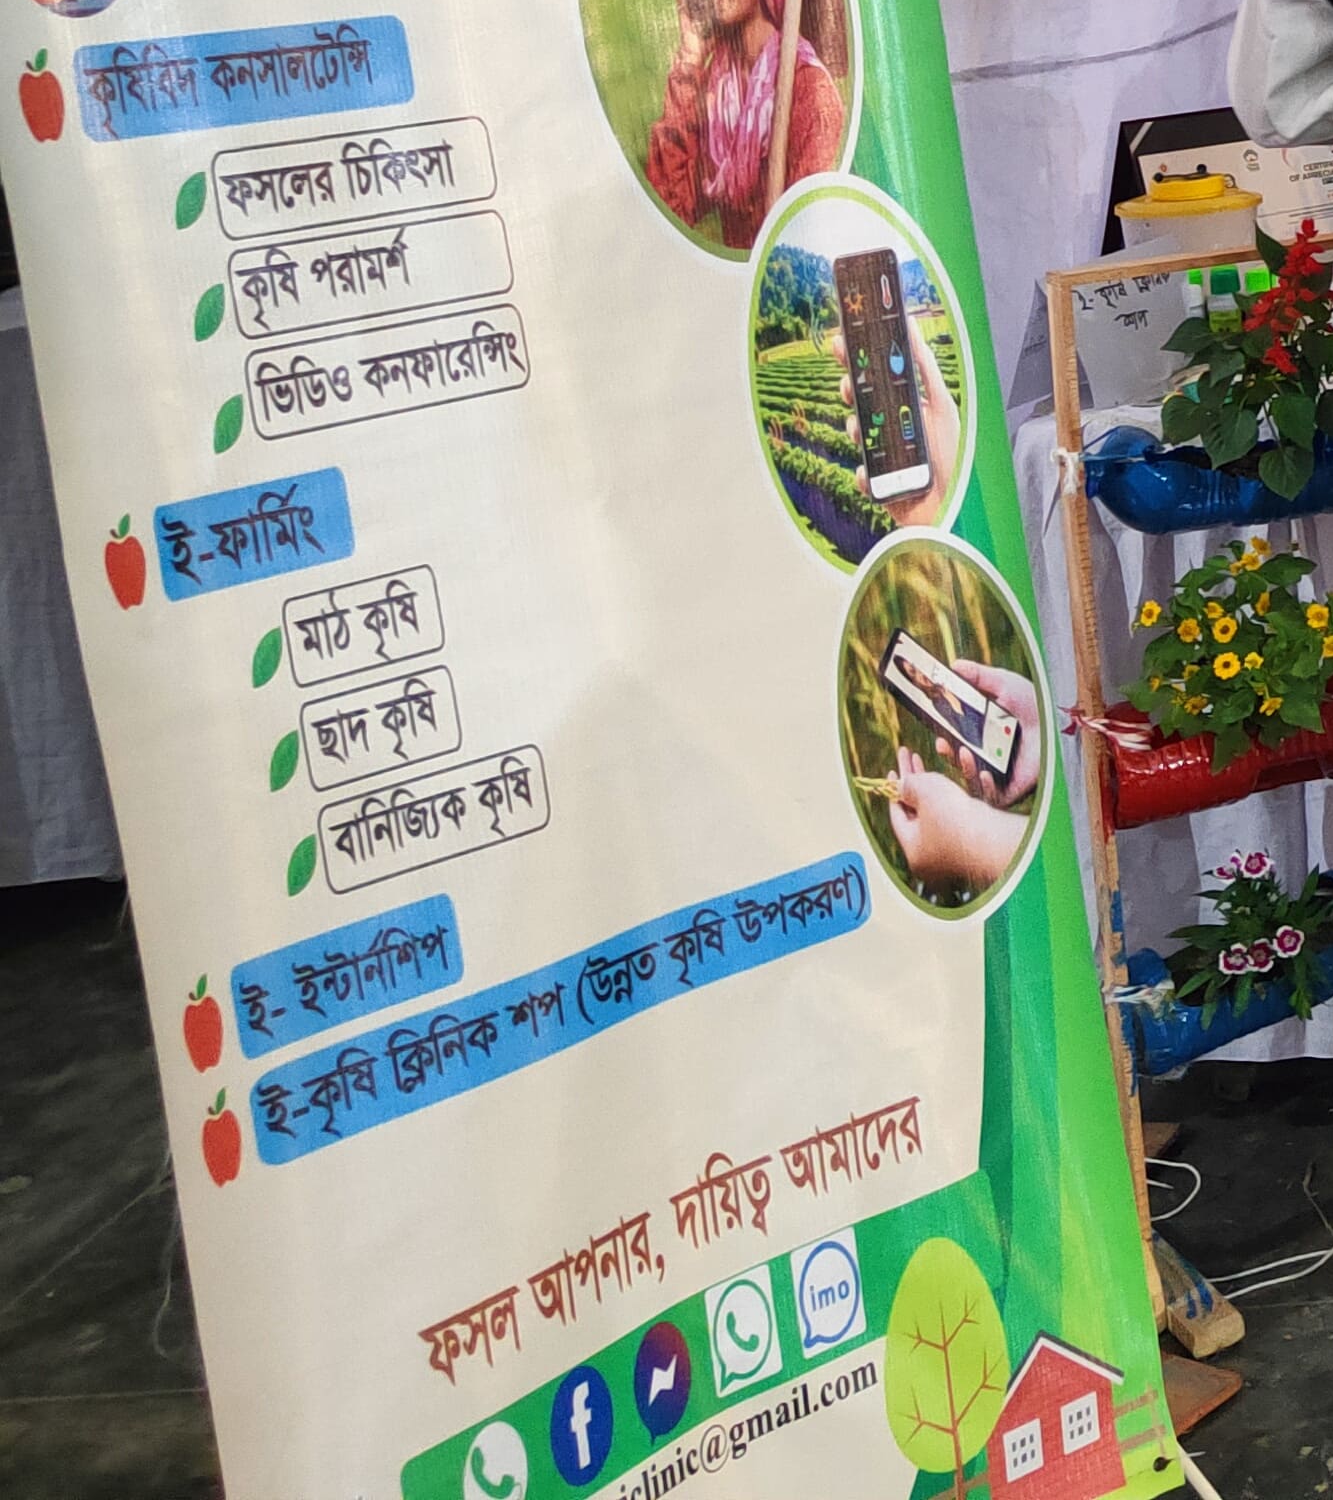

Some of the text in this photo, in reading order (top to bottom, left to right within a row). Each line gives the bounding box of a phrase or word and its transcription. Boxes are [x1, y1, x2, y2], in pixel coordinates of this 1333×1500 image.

[219, 137, 456, 217] ফসলের চিকিৎসা
[235, 225, 411, 331] কৃষি পরামর্শ
[254, 354, 353, 423] ভিডিও
[161, 483, 327, 586] ই-ফার্মিং
[293, 579, 419, 661] মাঠ কৃষি
[312, 676, 439, 762] ছাদ কৃষি
[472, 754, 537, 838] কৃষি
[256, 868, 868, 1139] ই-কৃষি ক্লিনিক শপ (উন্নত কৃষি উপকরণ)
[417, 1095, 924, 1385] ফসল আপনার, দায়িত্ব আমাদের
[808, 1277, 852, 1314] imo
